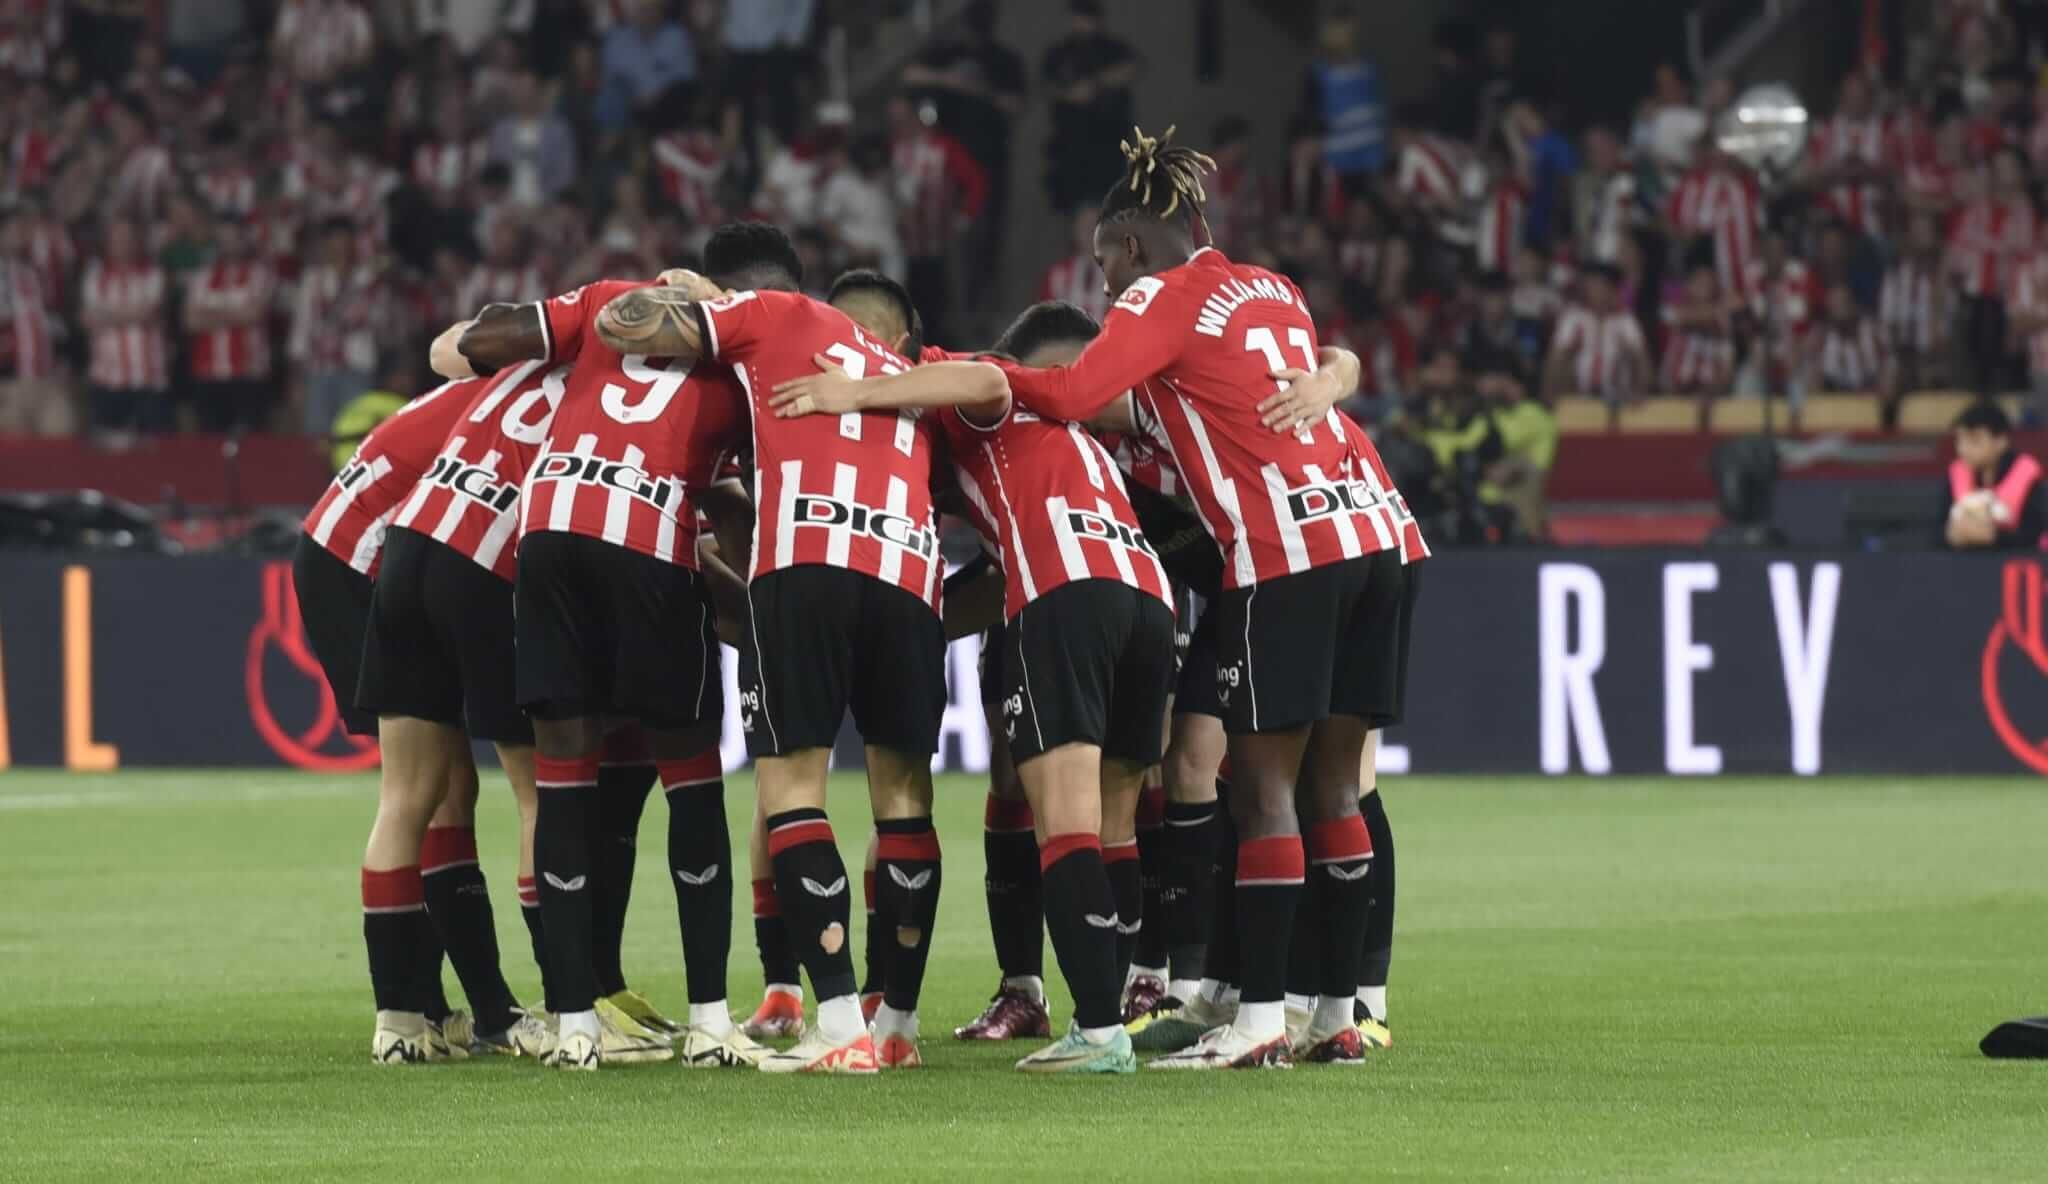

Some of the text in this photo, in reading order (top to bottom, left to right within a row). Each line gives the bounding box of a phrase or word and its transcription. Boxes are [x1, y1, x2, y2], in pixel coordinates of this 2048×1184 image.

[1195, 277, 1293, 338] WILLIAMS
[601, 353, 694, 424] 9
[1245, 326, 1345, 445] 11
[533, 454, 673, 509] DIGI
[793, 497, 935, 559] DIGI
[1538, 561, 1843, 776] REY
